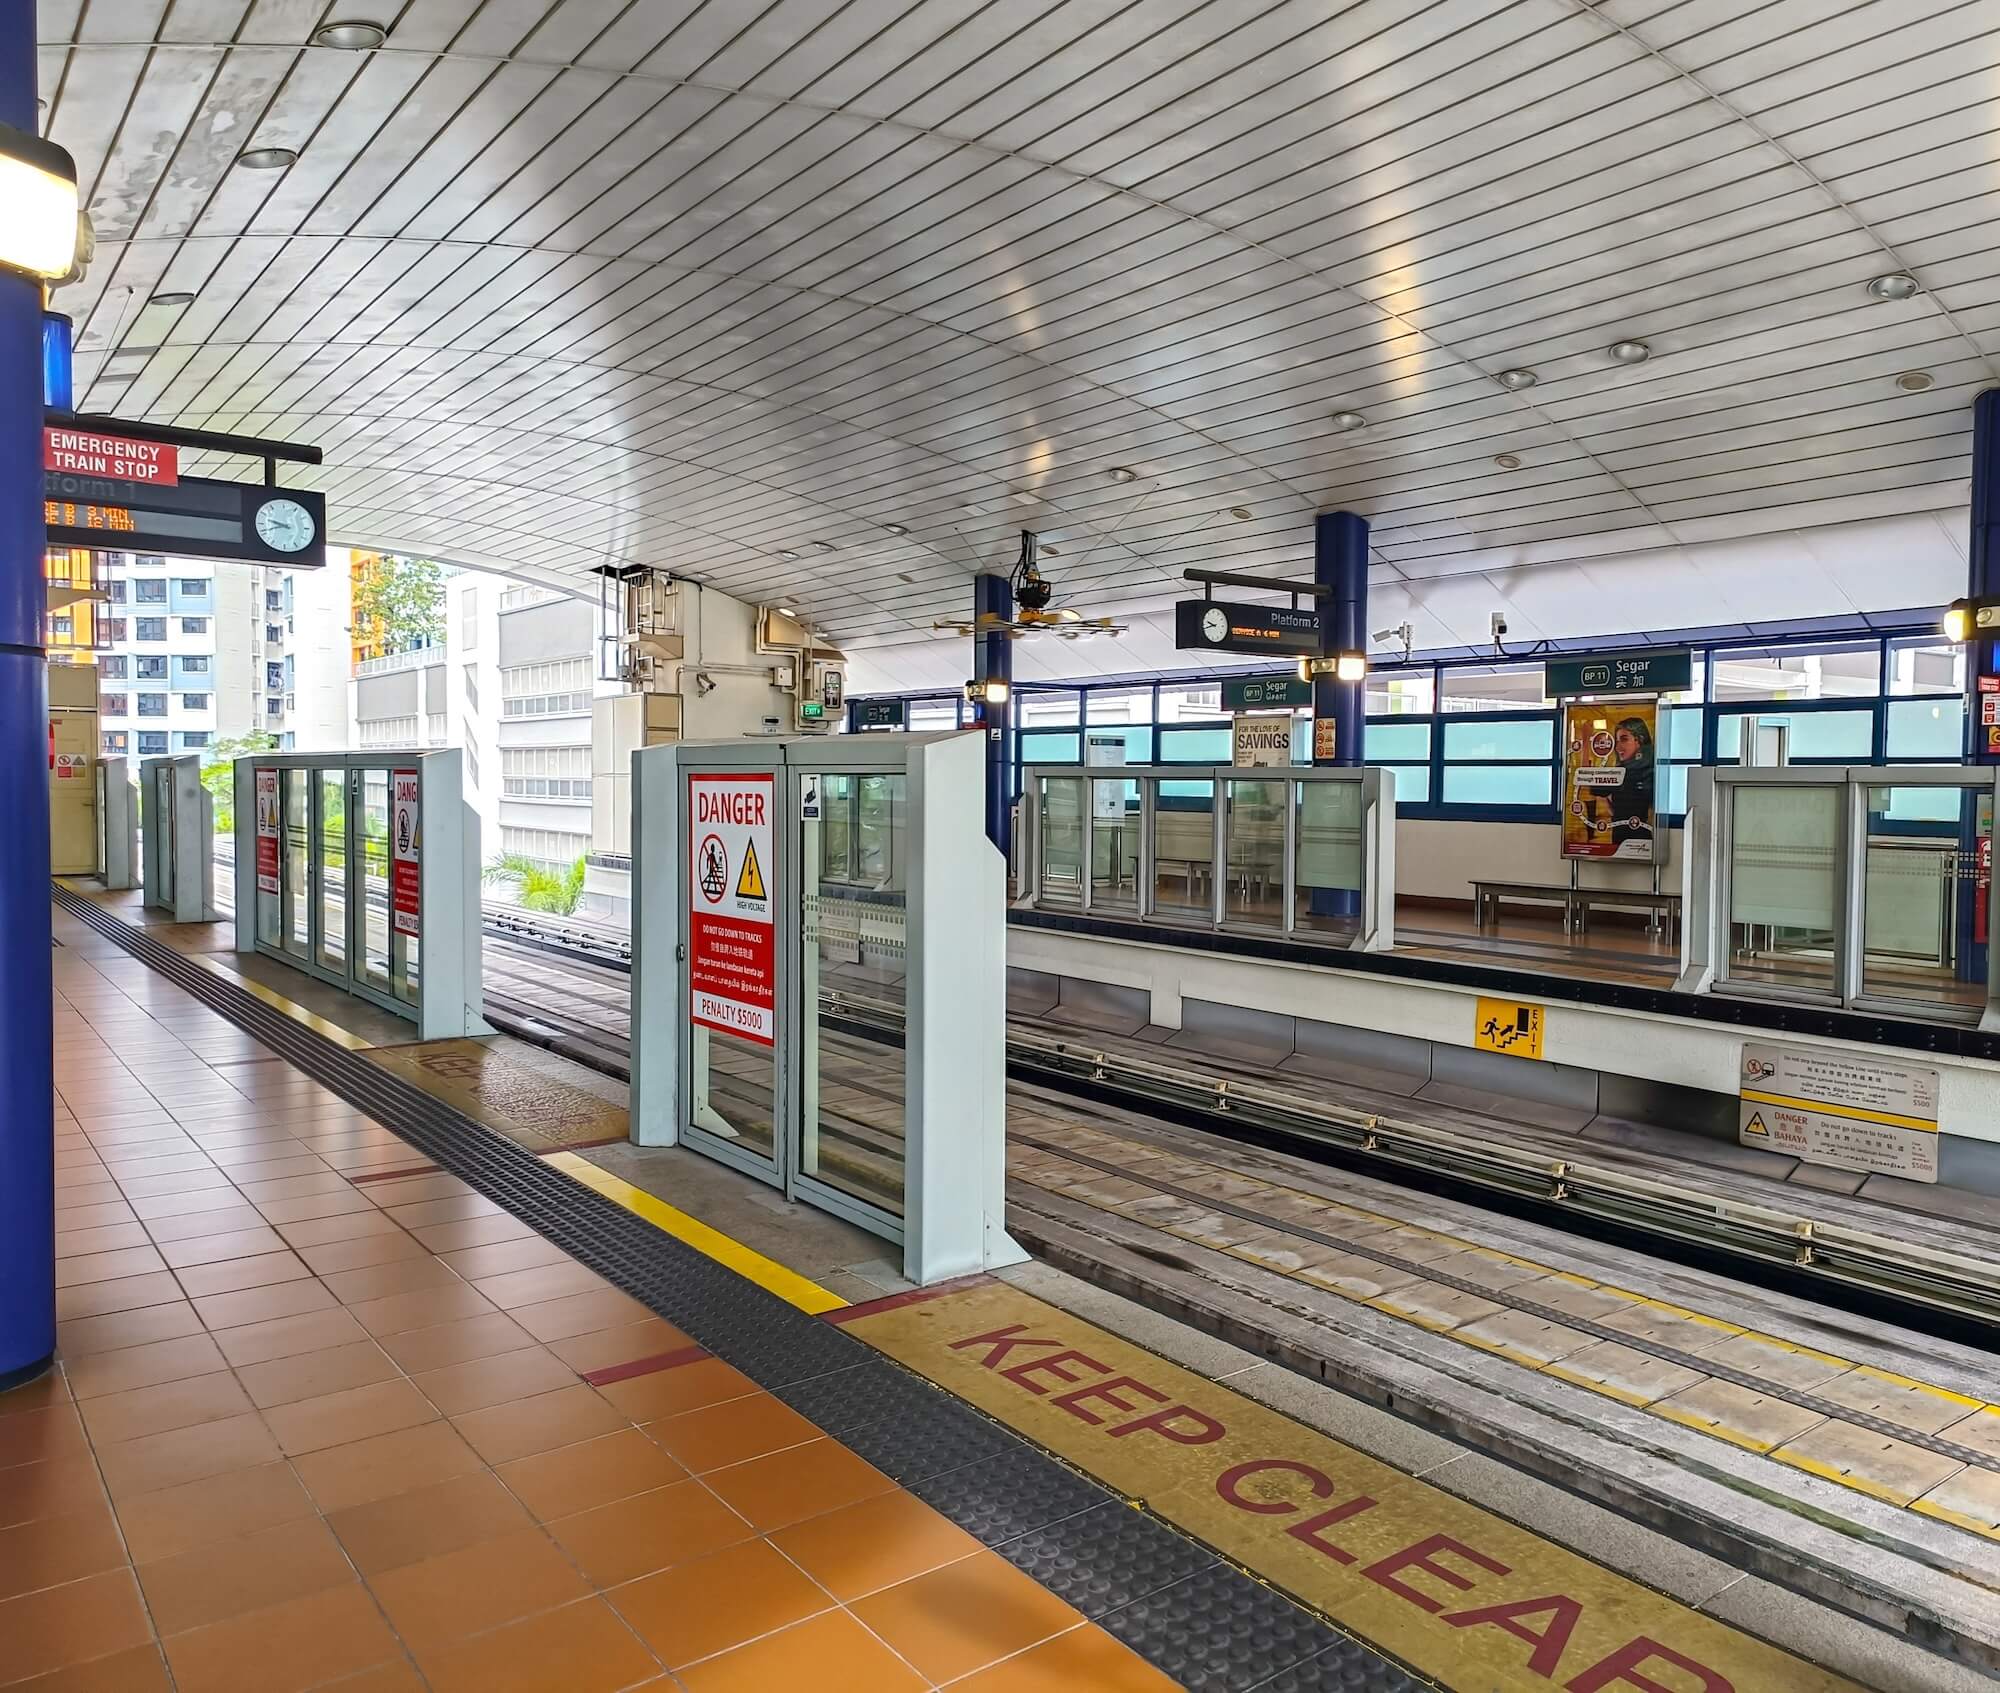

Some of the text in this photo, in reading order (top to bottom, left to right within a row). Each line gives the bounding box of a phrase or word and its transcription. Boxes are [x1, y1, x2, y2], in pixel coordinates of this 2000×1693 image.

[50, 432, 160, 461] EMERGENCY
[53, 451, 159, 479] TRAIN STOP
[1271, 613, 1320, 629] Platform 2
[1616, 660, 1651, 674] Segar
[1584, 671, 1606, 681] BP 11
[1266, 681, 1288, 693] Segar
[1250, 725, 1260, 733] THE
[1261, 725, 1272, 733] LOVE
[1238, 733, 1289, 749] SAVINGS
[259, 777, 275, 793] DANGER
[397, 782, 417, 801] DANG
[698, 792, 766, 825] DANGER
[736, 901, 766, 913] HIGH VOLTAGE
[703, 924, 763, 944] DO NOT GO DOWN TO TRACKS
[702, 998, 762, 1030] PENALTY $5000
[1530, 1009, 1538, 1055] EXIT
[1775, 1111, 1808, 1125] DANGER
[1775, 1131, 1808, 1145] BAHAYA
[1821, 1121, 1830, 1129] Do
[1831, 1122, 1840, 1130] not
[1842, 1125, 1850, 1133] go
[1851, 1127, 1869, 1136] down
[1877, 1132, 1897, 1140] tracks
[949, 1324, 1227, 1446] KEEP
